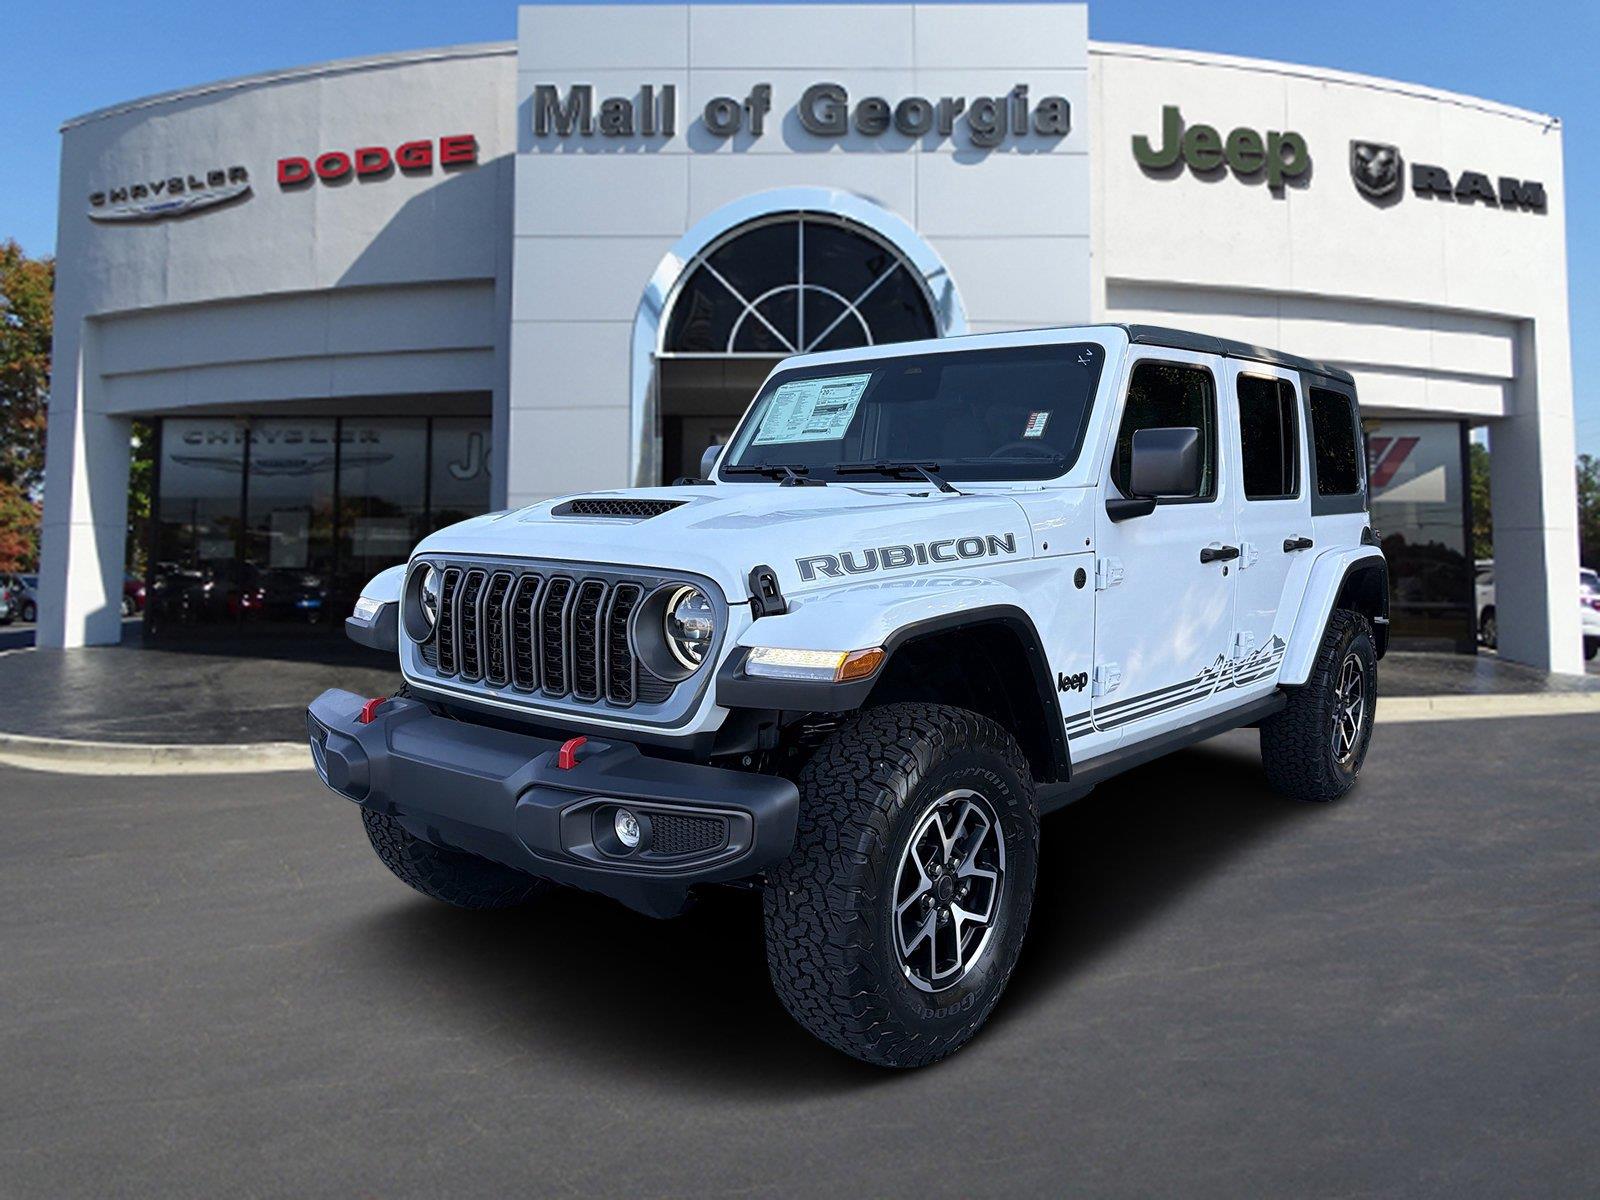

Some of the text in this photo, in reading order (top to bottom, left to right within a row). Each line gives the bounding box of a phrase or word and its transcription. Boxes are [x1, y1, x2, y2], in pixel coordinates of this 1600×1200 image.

[532, 82, 1072, 149] Mall of Georgia
[276, 134, 476, 187] DODGE
[1131, 104, 1310, 190] Jeep
[89, 165, 249, 207] CHRYSLER
[1411, 162, 1548, 216] RAM
[182, 429, 381, 445] CHRYSLER
[449, 431, 493, 481] J
[795, 532, 1017, 583] RUBICON
[1057, 671, 1089, 693] Jeep
